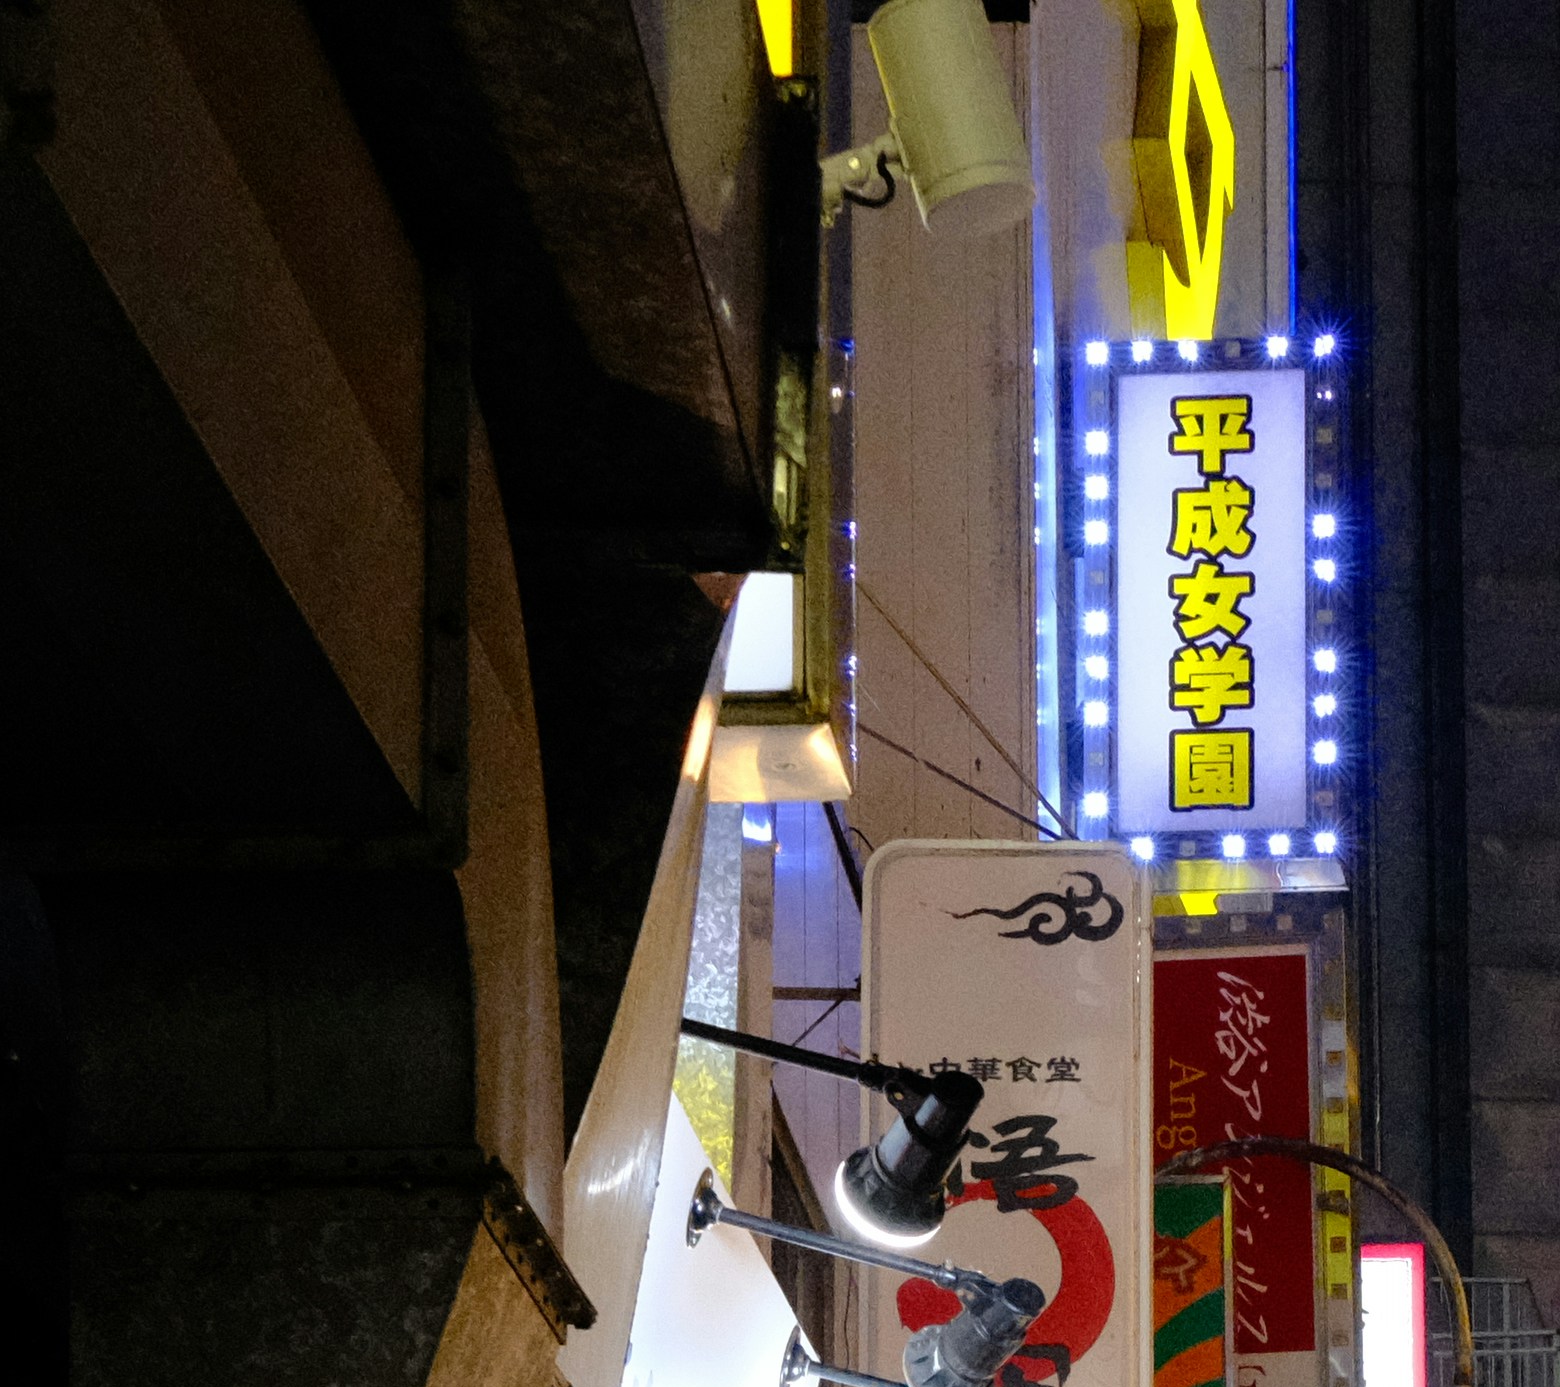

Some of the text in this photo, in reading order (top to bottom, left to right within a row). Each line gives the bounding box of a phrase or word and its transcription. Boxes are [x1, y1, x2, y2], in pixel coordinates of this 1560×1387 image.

[1169, 393, 1257, 812] 平成女学園
[927, 1056, 1081, 1084] 中華食堂
[1156, 1059, 1208, 1162] Ang
